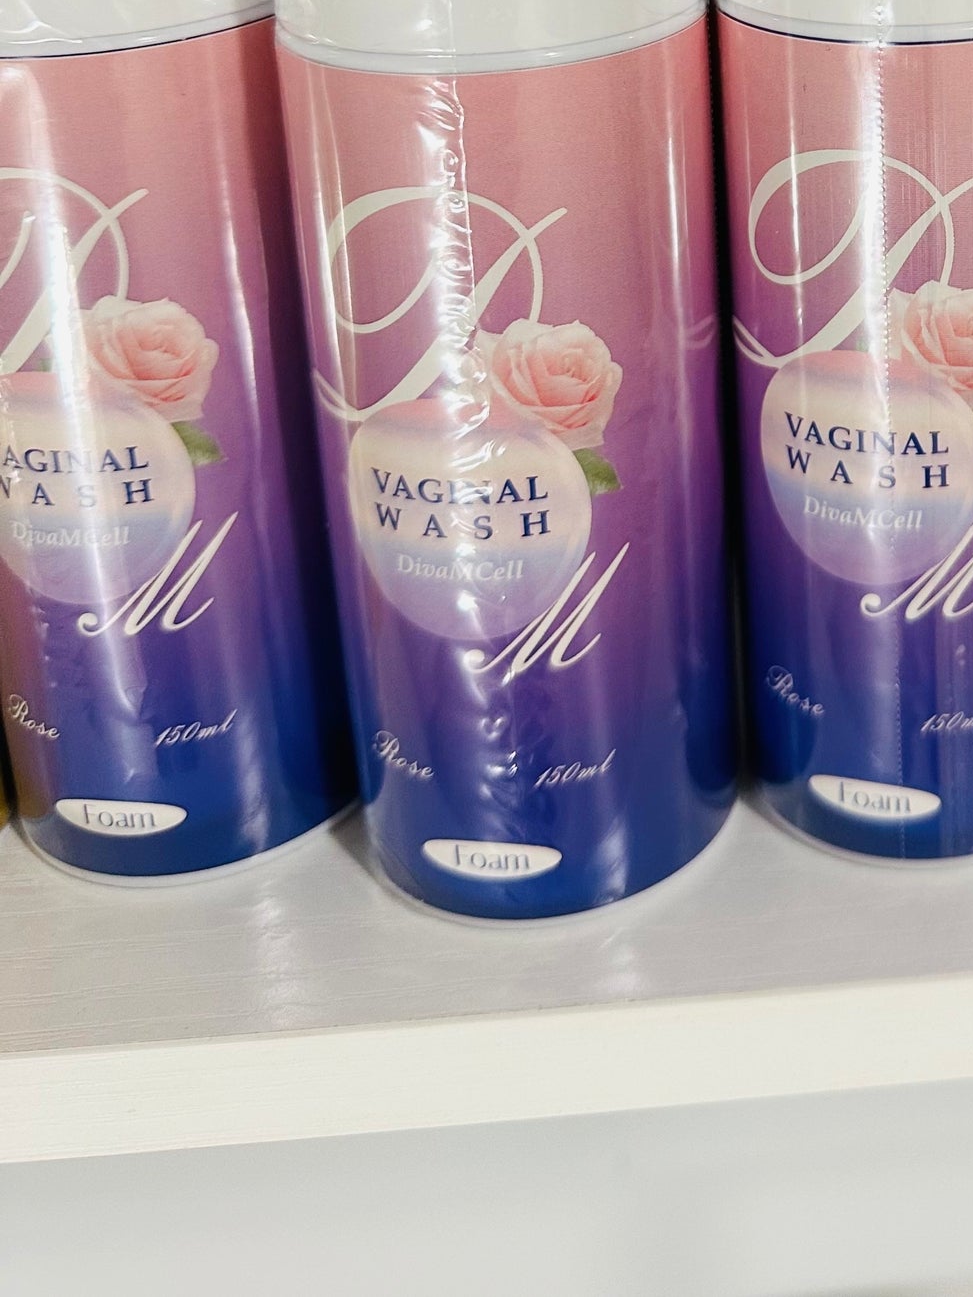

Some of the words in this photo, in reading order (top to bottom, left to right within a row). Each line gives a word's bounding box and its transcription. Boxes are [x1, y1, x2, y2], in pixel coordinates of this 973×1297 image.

[784, 410, 950, 456] VAGINAL
[3, 445, 150, 474] AGINAL
[784, 444, 950, 490] WASH
[373, 501, 552, 540] WASH
[803, 495, 924, 531] DivaMCell
[77, 511, 239, 637] M
[462, 541, 631, 673] M
[765, 664, 826, 718] Rose
[8, 693, 61, 739] Rose
[153, 708, 238, 749] 150ml
[372, 729, 436, 779] Rose
[532, 747, 618, 790] 150ml
[82, 803, 157, 829] Foam
[837, 780, 913, 815] Foam
[453, 843, 531, 871] Foam
